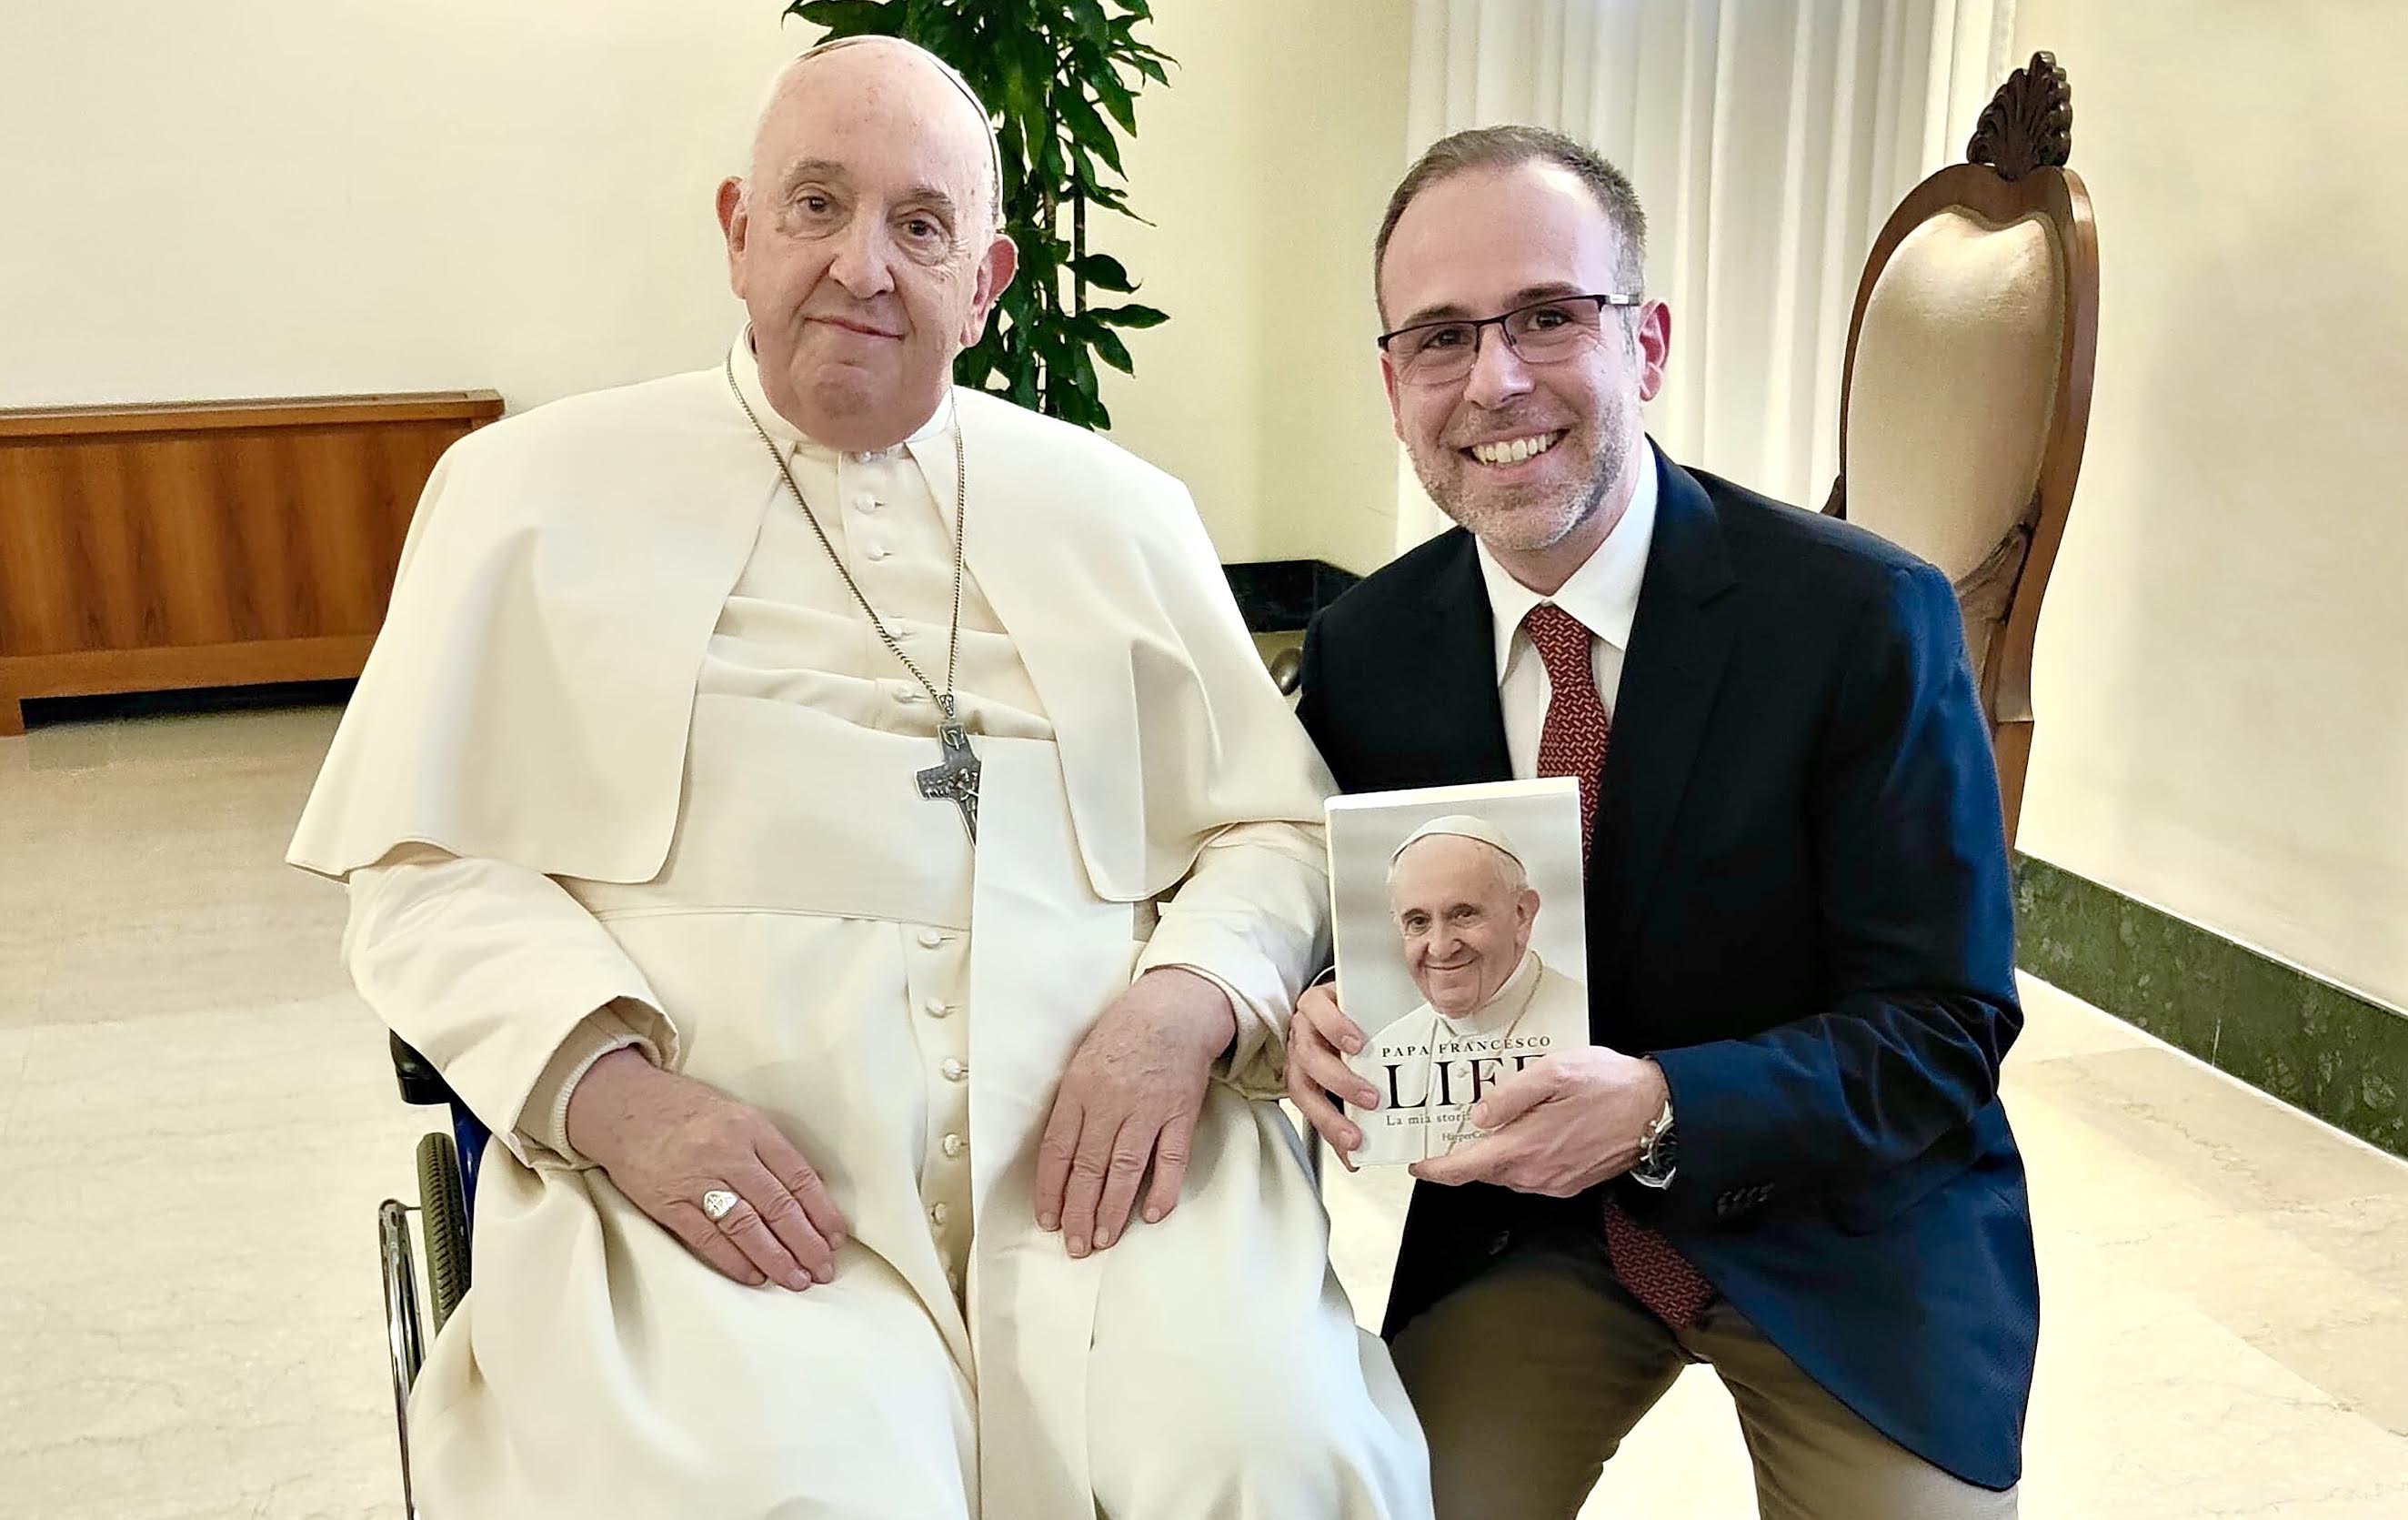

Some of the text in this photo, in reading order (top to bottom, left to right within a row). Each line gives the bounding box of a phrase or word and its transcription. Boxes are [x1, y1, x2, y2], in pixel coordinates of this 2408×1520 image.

[1381, 1035, 1551, 1058] PAPA FRANCESCO
[1386, 1114, 1403, 1126] La
[1408, 1112, 1431, 1125] mia
[1441, 1129, 1486, 1143] HarperCo
